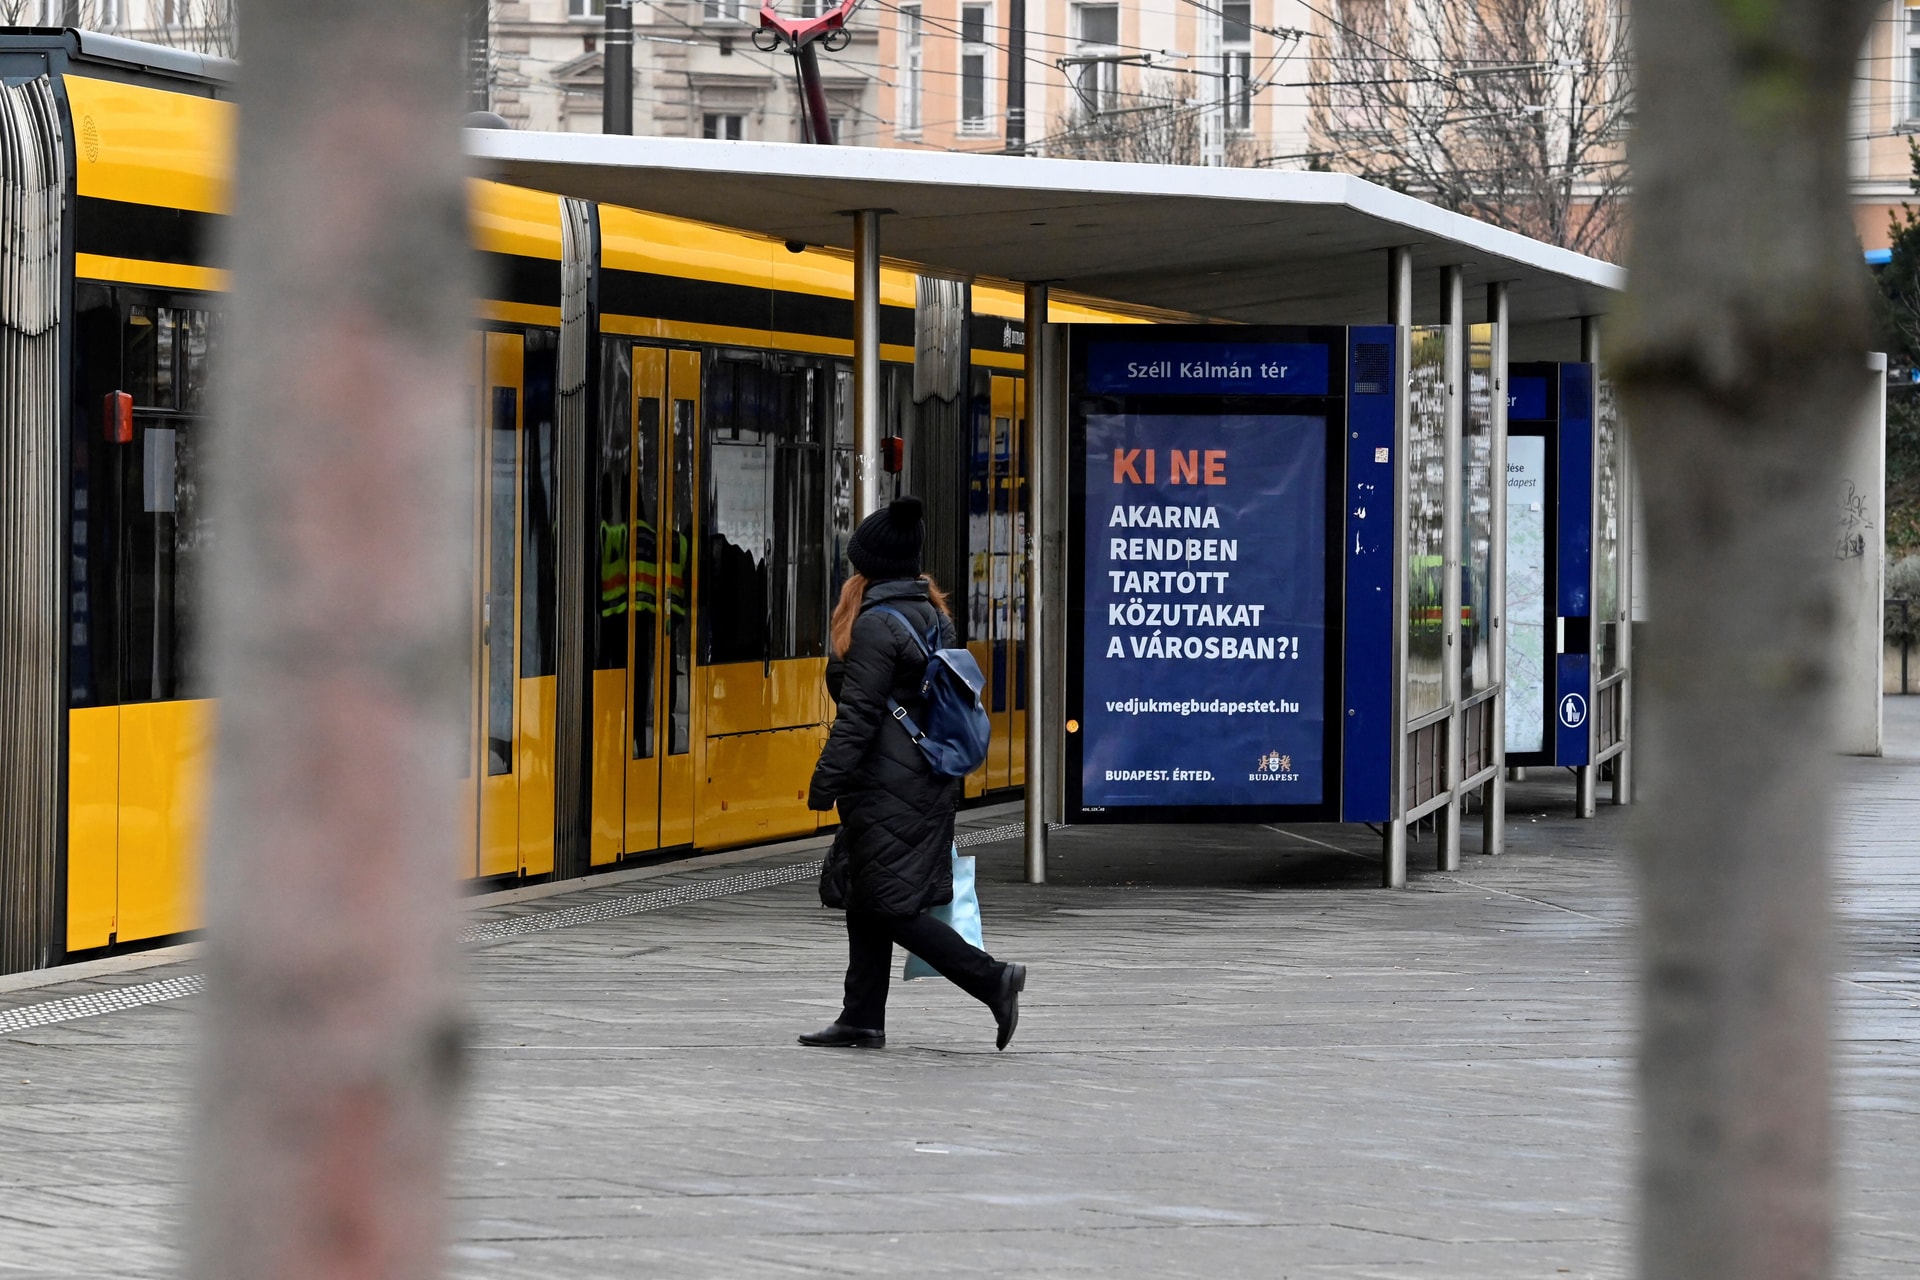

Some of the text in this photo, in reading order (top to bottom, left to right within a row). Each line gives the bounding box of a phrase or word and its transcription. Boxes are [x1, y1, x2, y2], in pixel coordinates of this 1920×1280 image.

[1127, 361, 1288, 379] Széll Kálmán tér
[1113, 447, 1227, 486] KI NE
[1507, 477, 1536, 489] dapest
[1108, 505, 1221, 529] AKARNA
[1110, 537, 1238, 562] RENDBEN
[1108, 570, 1230, 594] TARTOTT
[1108, 597, 1265, 627] KÖZUTAKAT
[1105, 629, 1299, 660] A VÁROSBAN?!
[1105, 697, 1300, 716] vedjukmegbudapestet.hu
[1105, 767, 1216, 782] BUDAPEST. ÉRTED.
[1248, 773, 1300, 782] BUDAPEST
